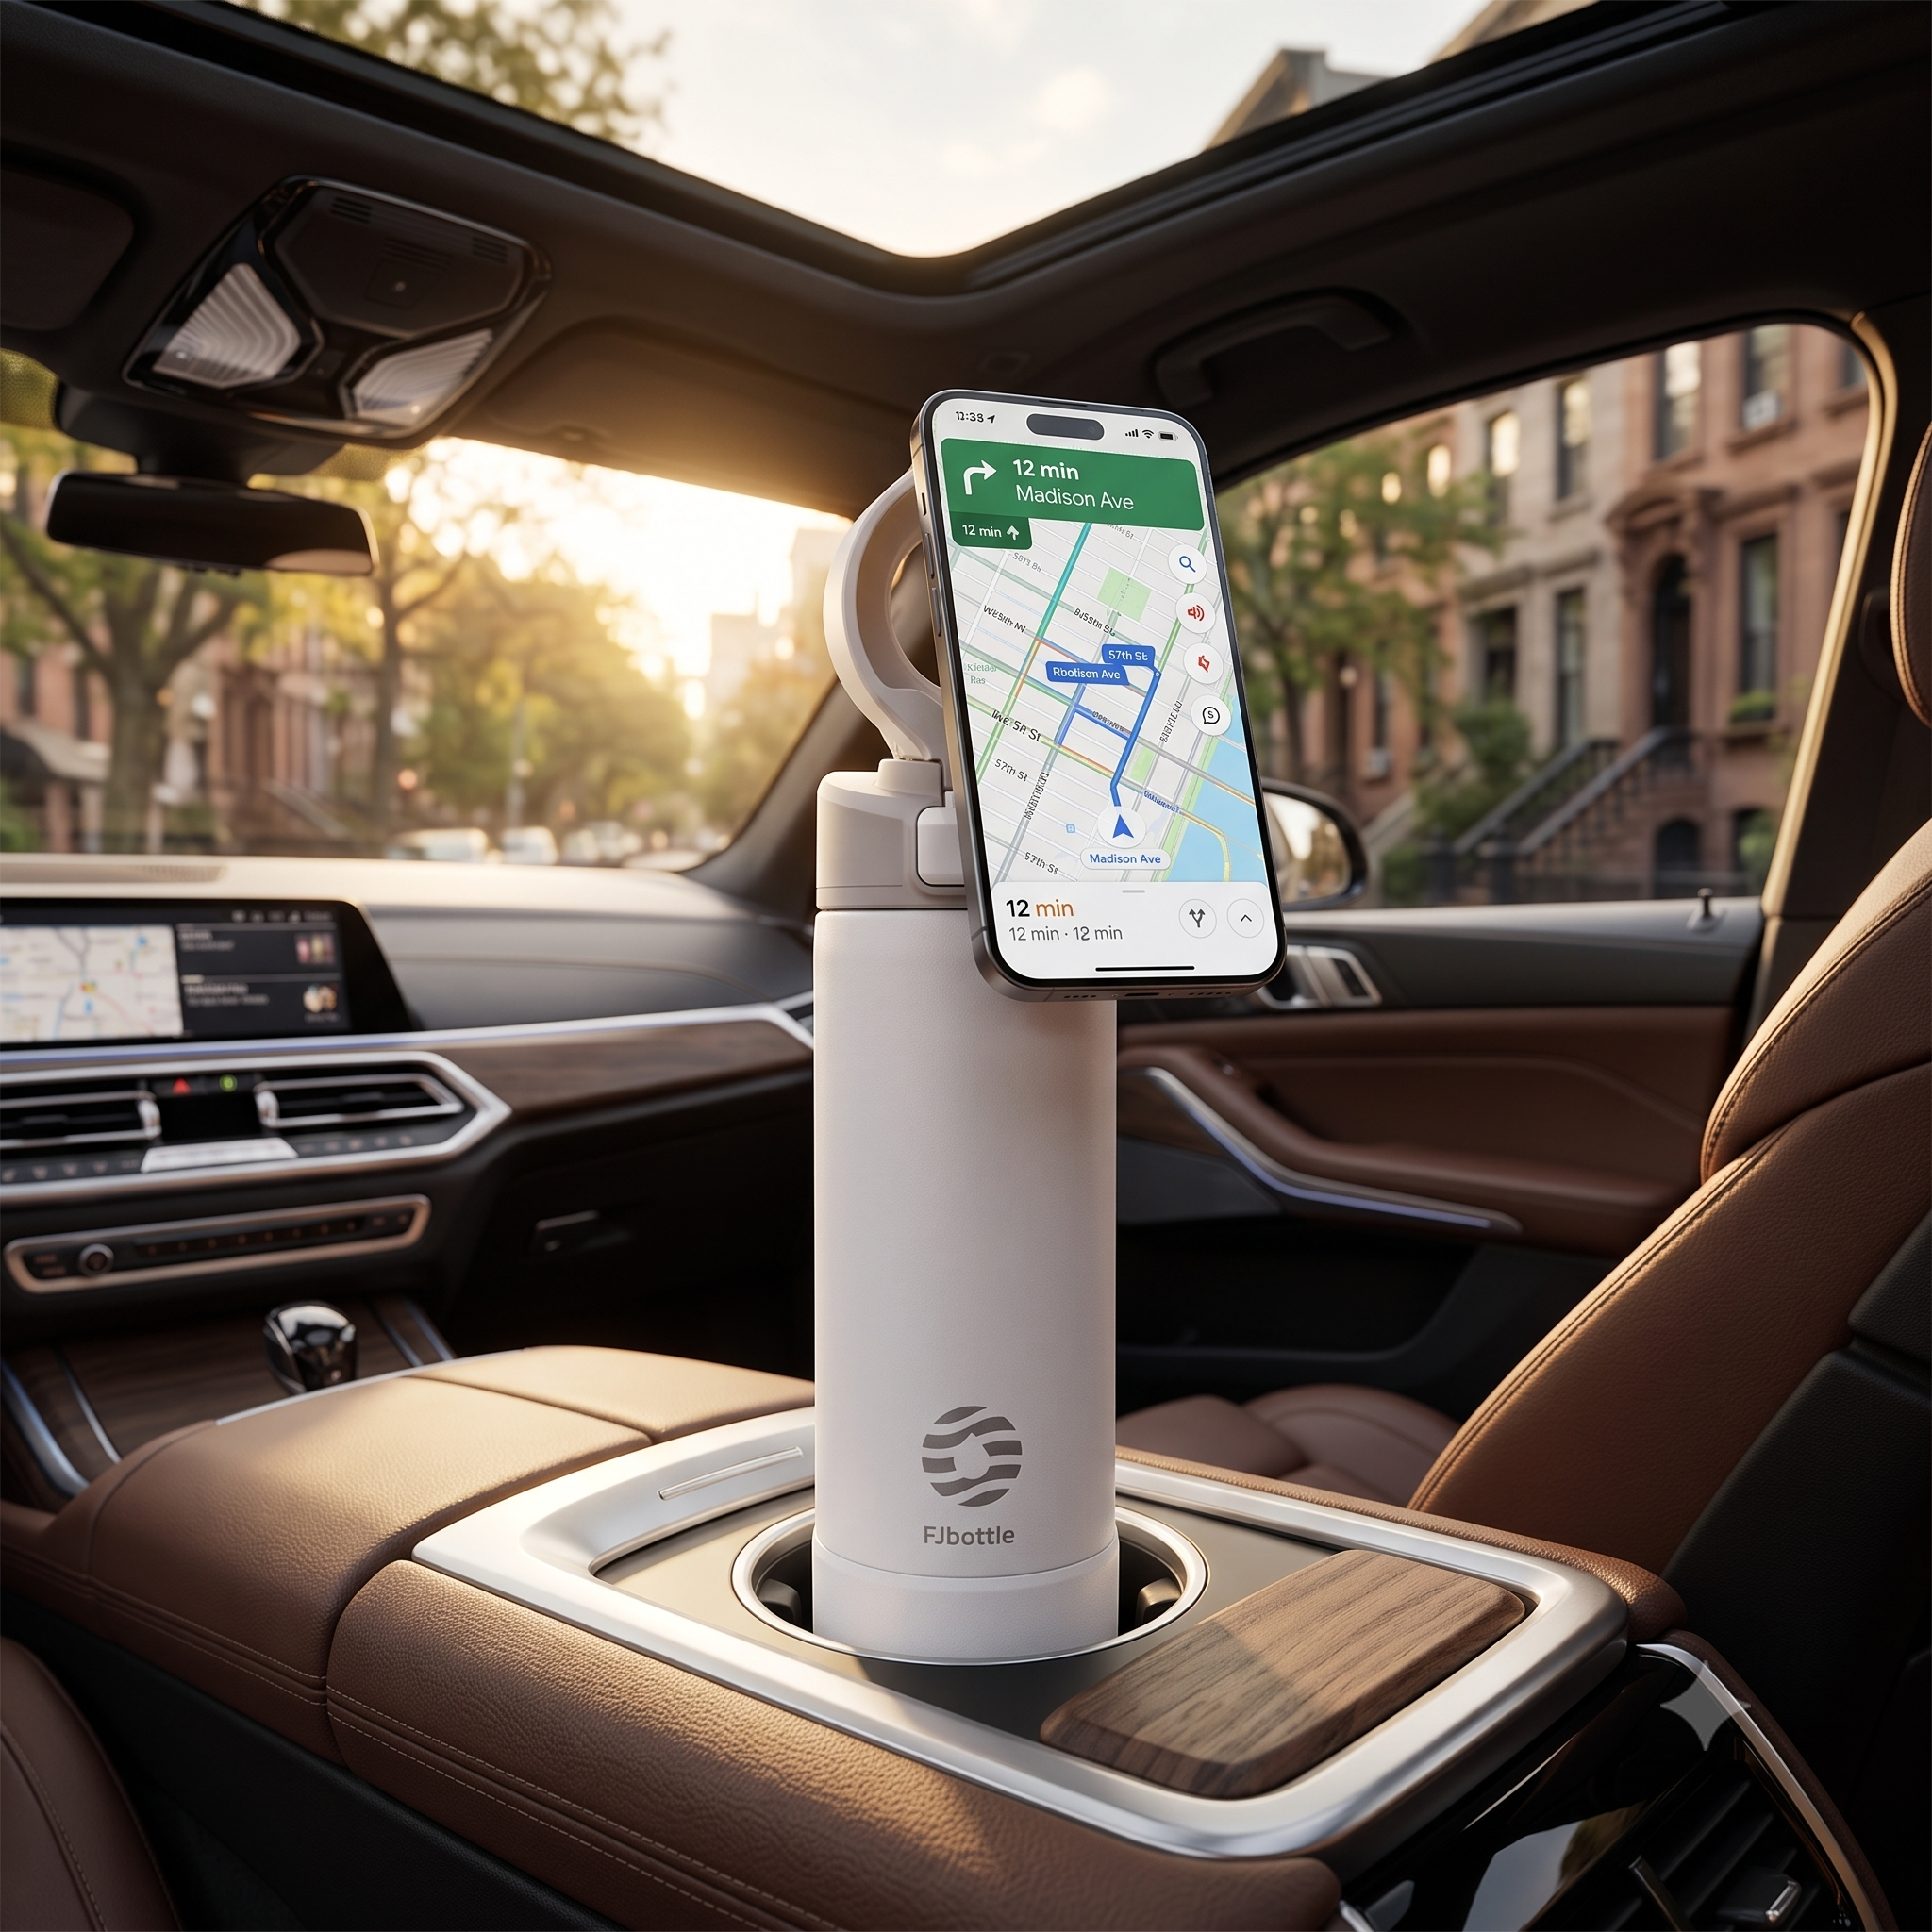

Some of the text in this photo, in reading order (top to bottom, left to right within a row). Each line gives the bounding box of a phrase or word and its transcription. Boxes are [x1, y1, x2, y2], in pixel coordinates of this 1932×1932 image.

[1012, 458, 1079, 480] 12 min
[1016, 484, 1134, 509] Madison Ave
[962, 525, 1002, 538] 12 min
[1108, 650, 1148, 661] 57th St
[1101, 669, 1121, 679] Ave
[1090, 853, 1161, 864] Madison Ave
[1006, 898, 1074, 917] 12 min
[1009, 925, 1123, 941] 12 min 12 min
[924, 1525, 1015, 1545] FJbottle
